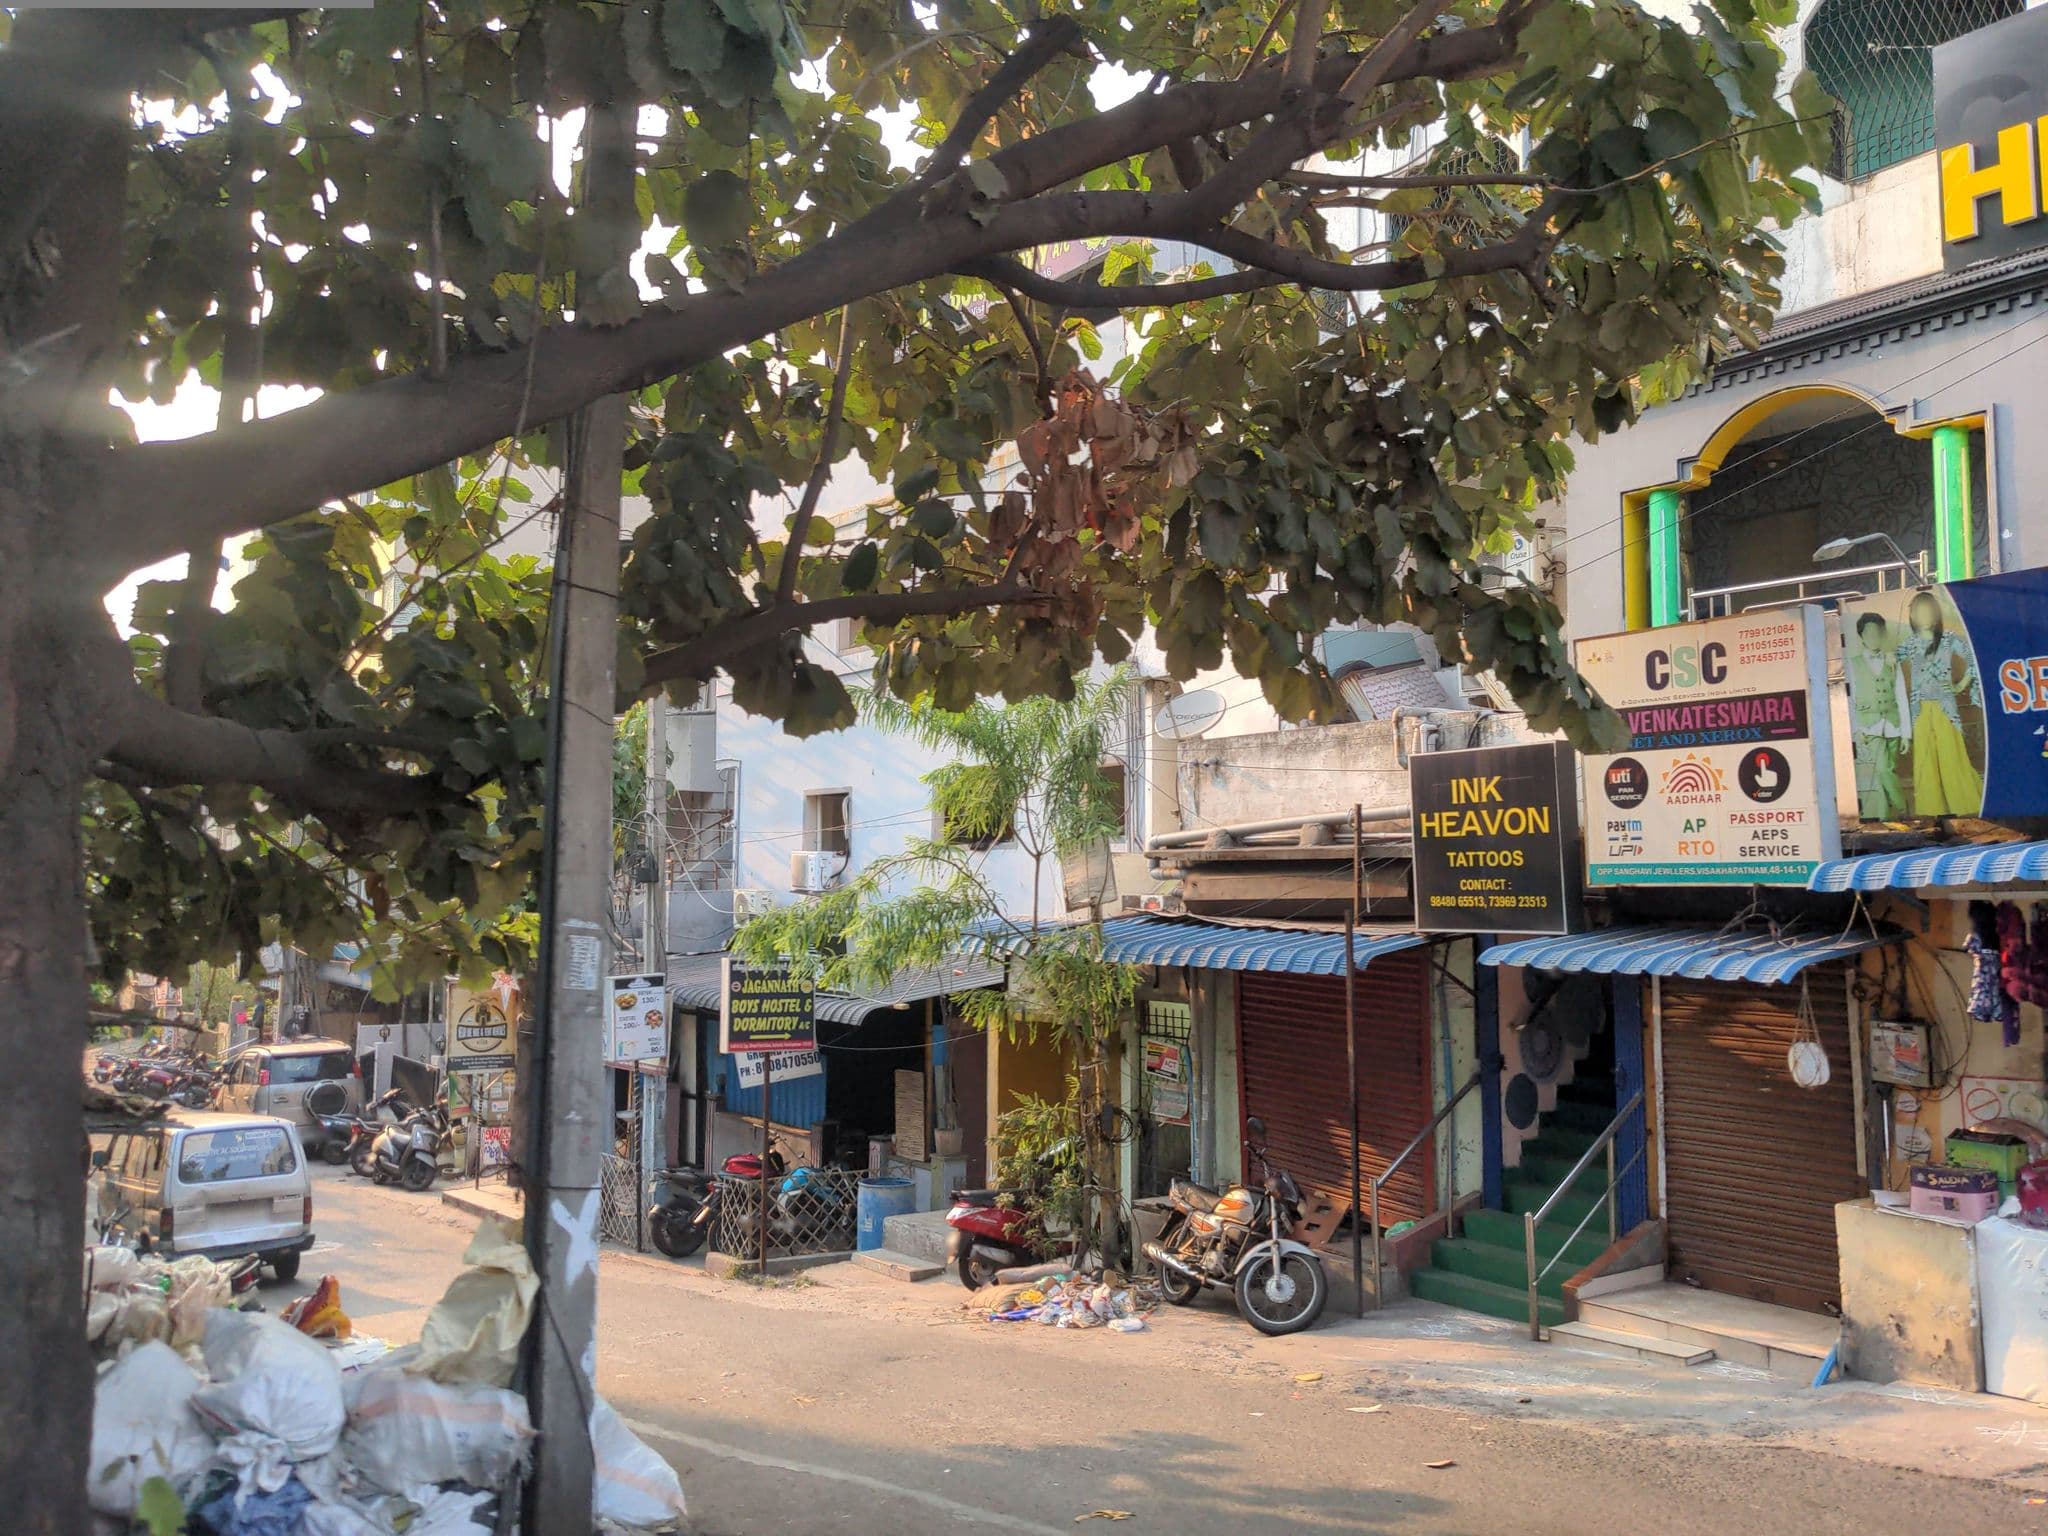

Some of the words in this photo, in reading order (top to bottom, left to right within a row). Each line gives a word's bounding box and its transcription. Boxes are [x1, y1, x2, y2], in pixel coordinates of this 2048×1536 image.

[1738, 624, 1795, 640] 7799121084
[1739, 650, 1795, 665] 8374557337
[1645, 641, 1728, 691] CSC
[1628, 696, 1796, 735] VENKATESWARA
[1658, 731, 1697, 747] AND
[1700, 727, 1764, 745] XEROX
[1451, 775, 1504, 805] INK
[1666, 793, 1722, 805] AADHAAR
[1420, 806, 1550, 838] HEAVON
[1682, 818, 1706, 833] AP
[1730, 811, 1805, 825] PASSPORT
[1752, 828, 1789, 841] AEPS
[1678, 840, 1715, 856] RTO
[1739, 845, 1801, 857] SERVICE
[1447, 850, 1525, 867] TATTOOS
[1518, 895, 1548, 908] 23513
[742, 979, 799, 994] JAGANNATH
[731, 999, 760, 1014] BOYS
[761, 998, 801, 1013] HOSTEL
[804, 998, 812, 1013] &
[733, 1016, 799, 1032] DORMITORY
[755, 1051, 820, 1074] 808470550
